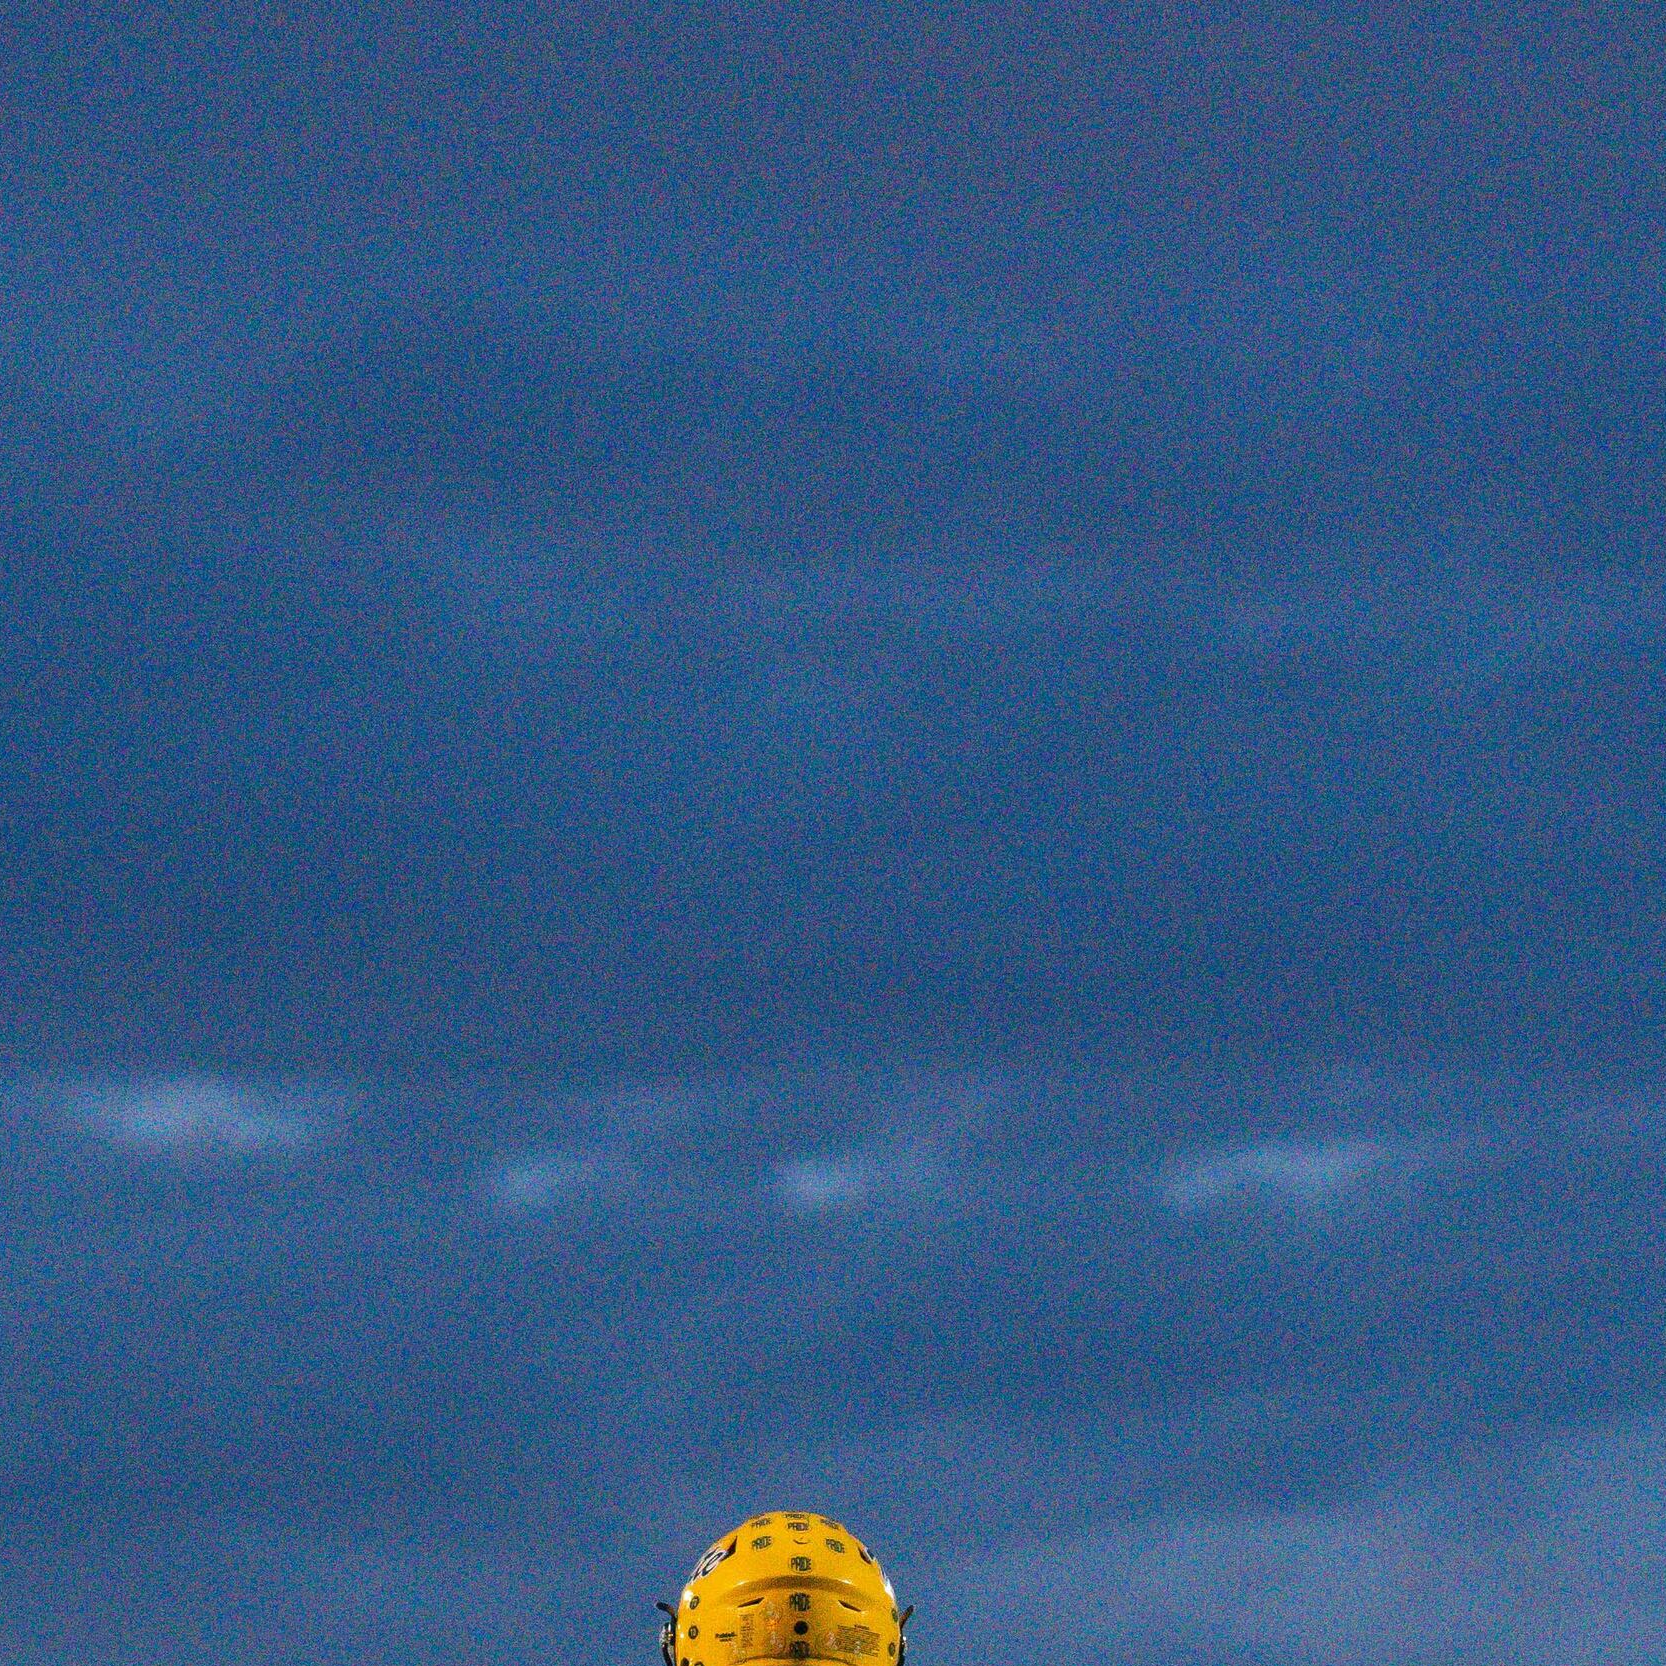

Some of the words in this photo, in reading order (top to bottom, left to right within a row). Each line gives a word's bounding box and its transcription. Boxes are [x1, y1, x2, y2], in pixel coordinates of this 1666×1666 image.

[751, 1536, 772, 1551] PRIDE
[825, 1538, 845, 1554] PRIDE
[791, 1556, 812, 1571] PRIDE
[789, 1592, 811, 1612] PRIDE
